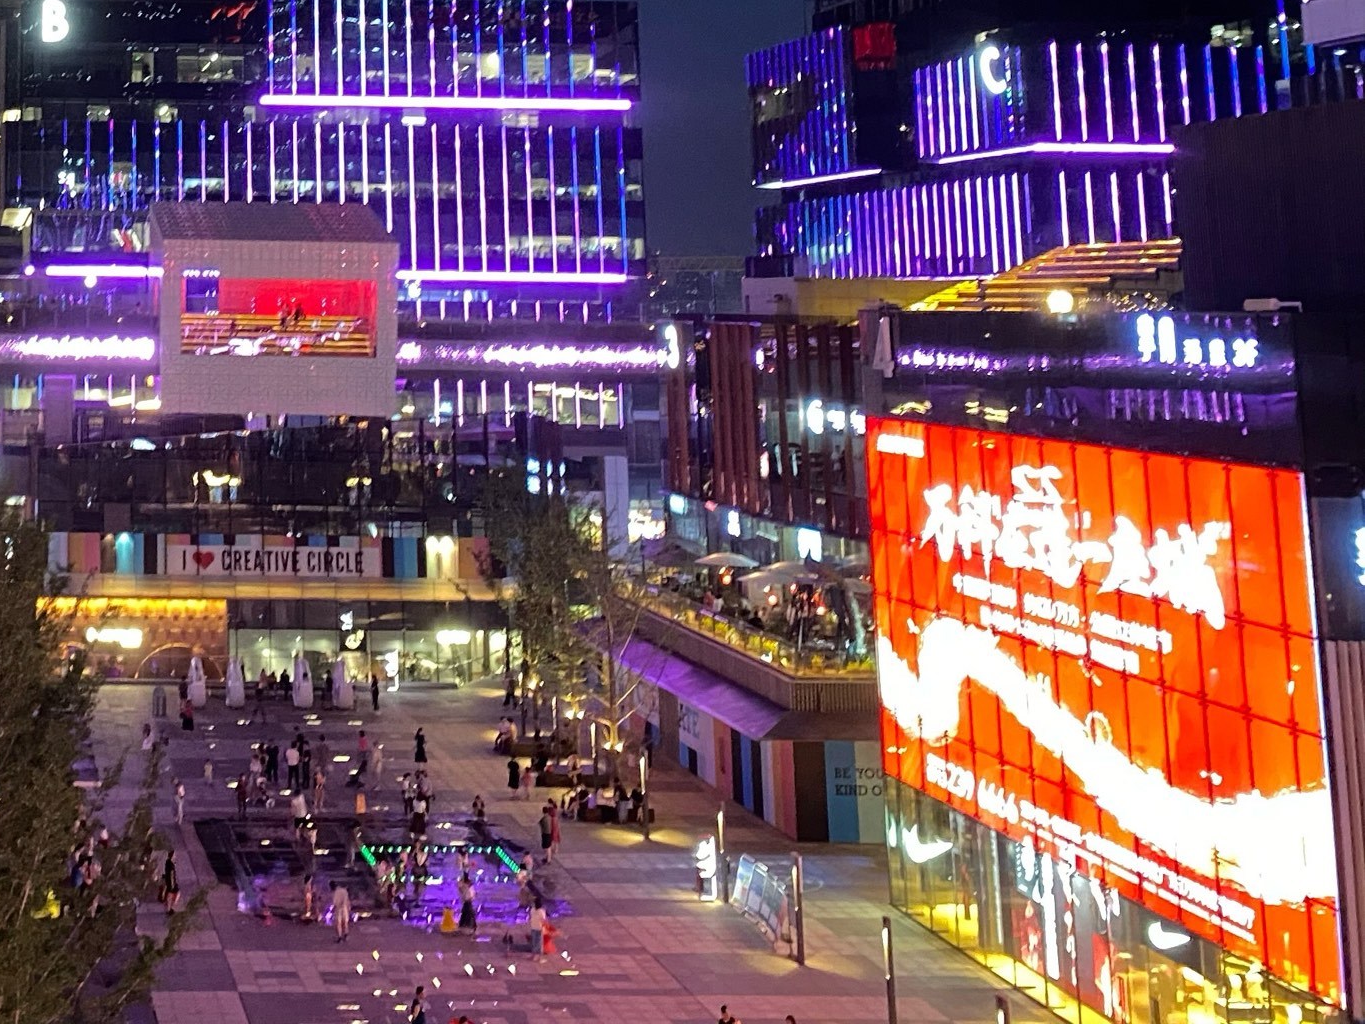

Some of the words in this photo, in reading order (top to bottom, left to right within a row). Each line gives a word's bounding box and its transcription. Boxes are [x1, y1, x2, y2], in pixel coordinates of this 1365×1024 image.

[980, 46, 1007, 94] C
[222, 550, 300, 573] CREATIVE
[307, 550, 364, 574] CIRCLE
[834, 767, 852, 779] BE
[835, 784, 868, 796] KIND
